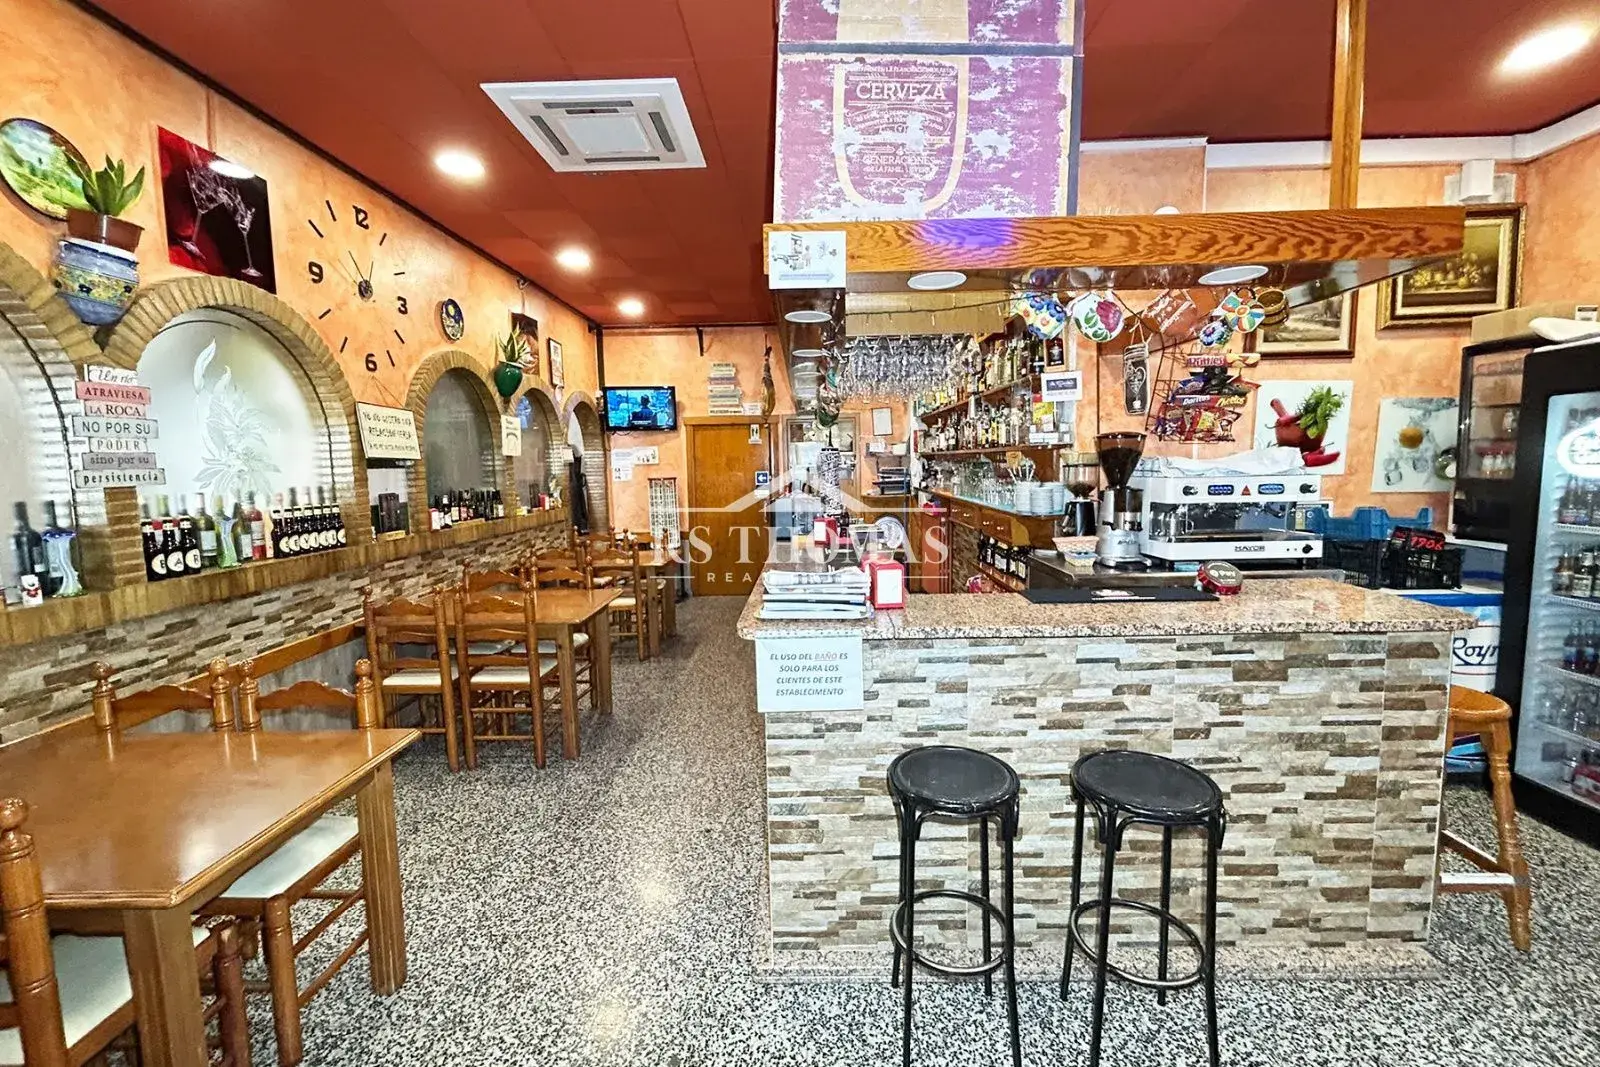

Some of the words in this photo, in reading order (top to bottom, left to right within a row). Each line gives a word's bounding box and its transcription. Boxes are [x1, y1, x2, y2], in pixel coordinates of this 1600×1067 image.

[856, 82, 946, 100] CERVEZA
[862, 155, 936, 165] GENERACIONES
[352, 204, 370, 230] 12
[308, 261, 323, 284] 9
[397, 296, 408, 315] 3
[365, 353, 377, 372] 6
[84, 386, 145, 400] ATRAVIESA
[90, 406, 102, 414] LA
[82, 421, 100, 432] NO
[105, 422, 131, 434] POR
[135, 424, 151, 435] SU
[97, 439, 140, 451] PODER
[90, 451, 114, 465] sino
[117, 457, 135, 467] por
[83, 471, 158, 485] persistencia
[814, 651, 838, 661] BAÑO
[824, 664, 839, 672] LOS
[776, 676, 811, 684] CLIENTES
